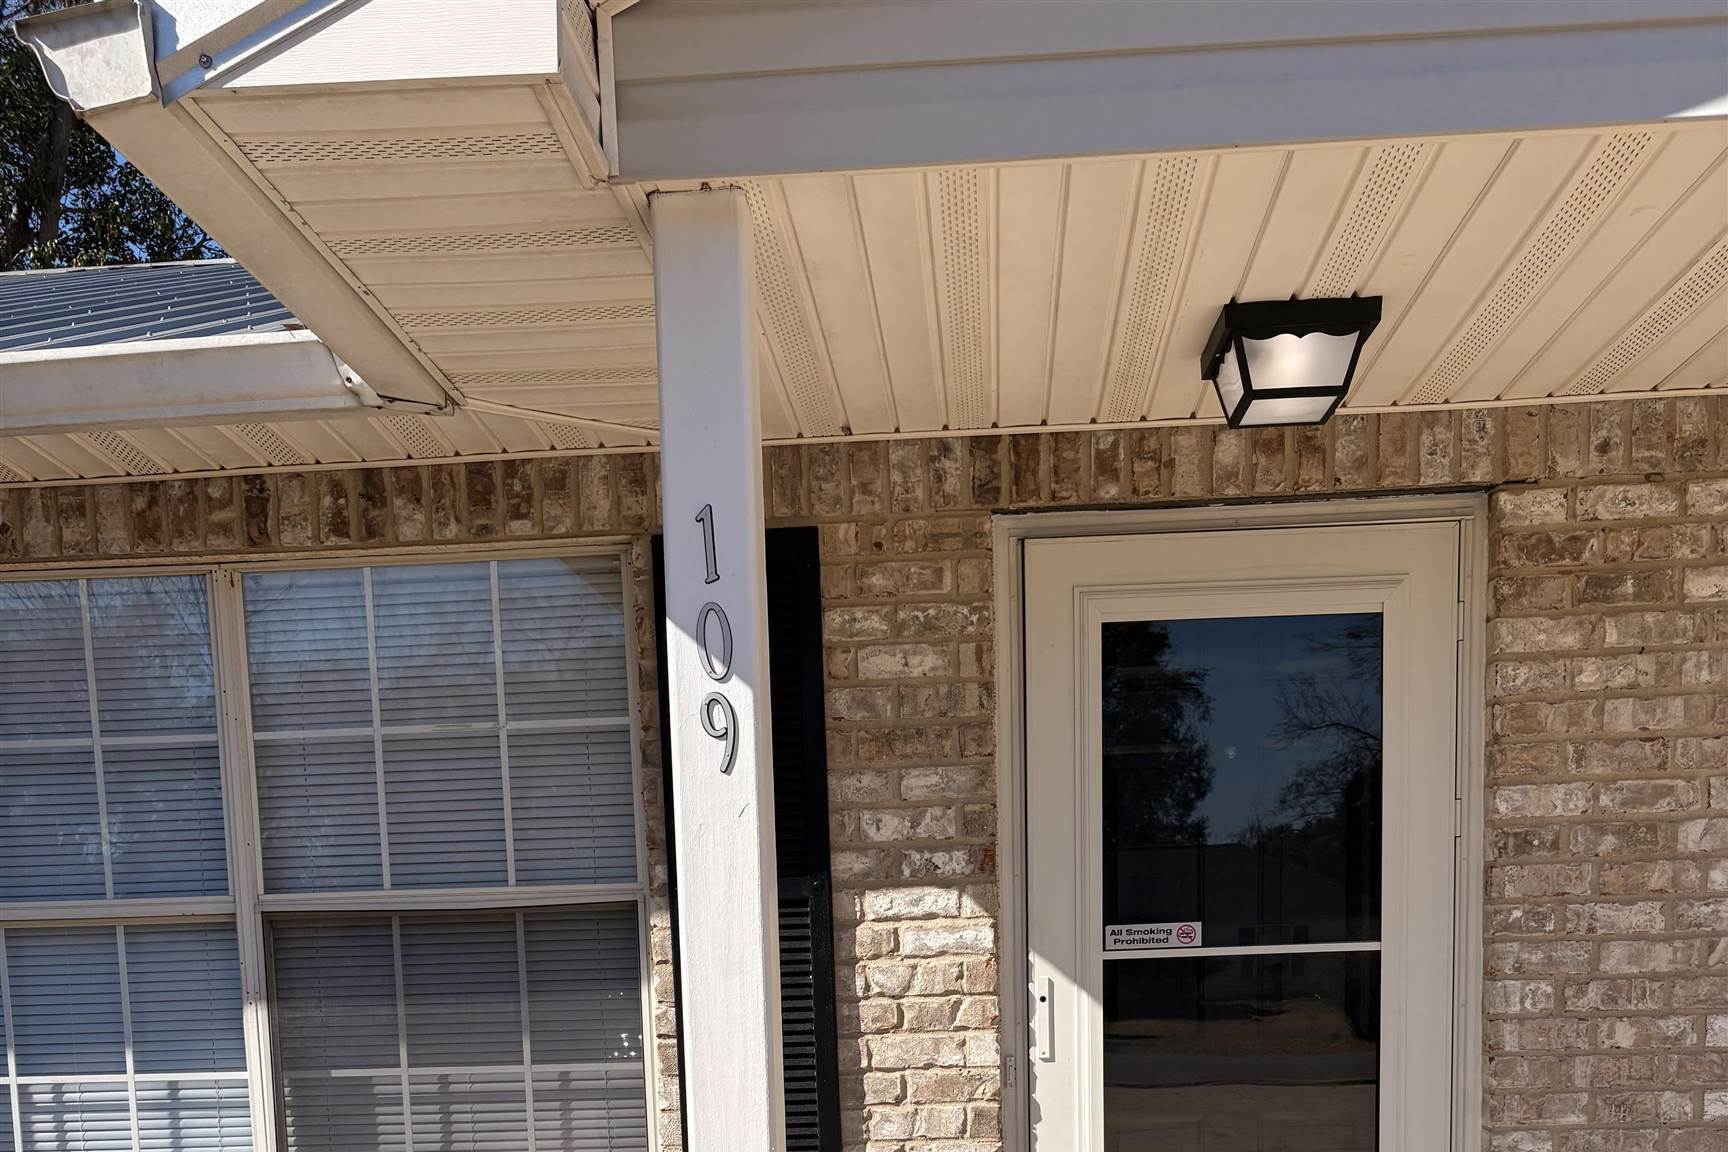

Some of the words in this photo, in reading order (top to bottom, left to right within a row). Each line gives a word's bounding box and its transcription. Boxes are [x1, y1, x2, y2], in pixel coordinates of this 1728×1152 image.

[695, 503, 735, 773] 109
[1110, 928, 1122, 937] All
[1125, 927, 1173, 936] Smoking
[1113, 936, 1169, 946] Prohibited
